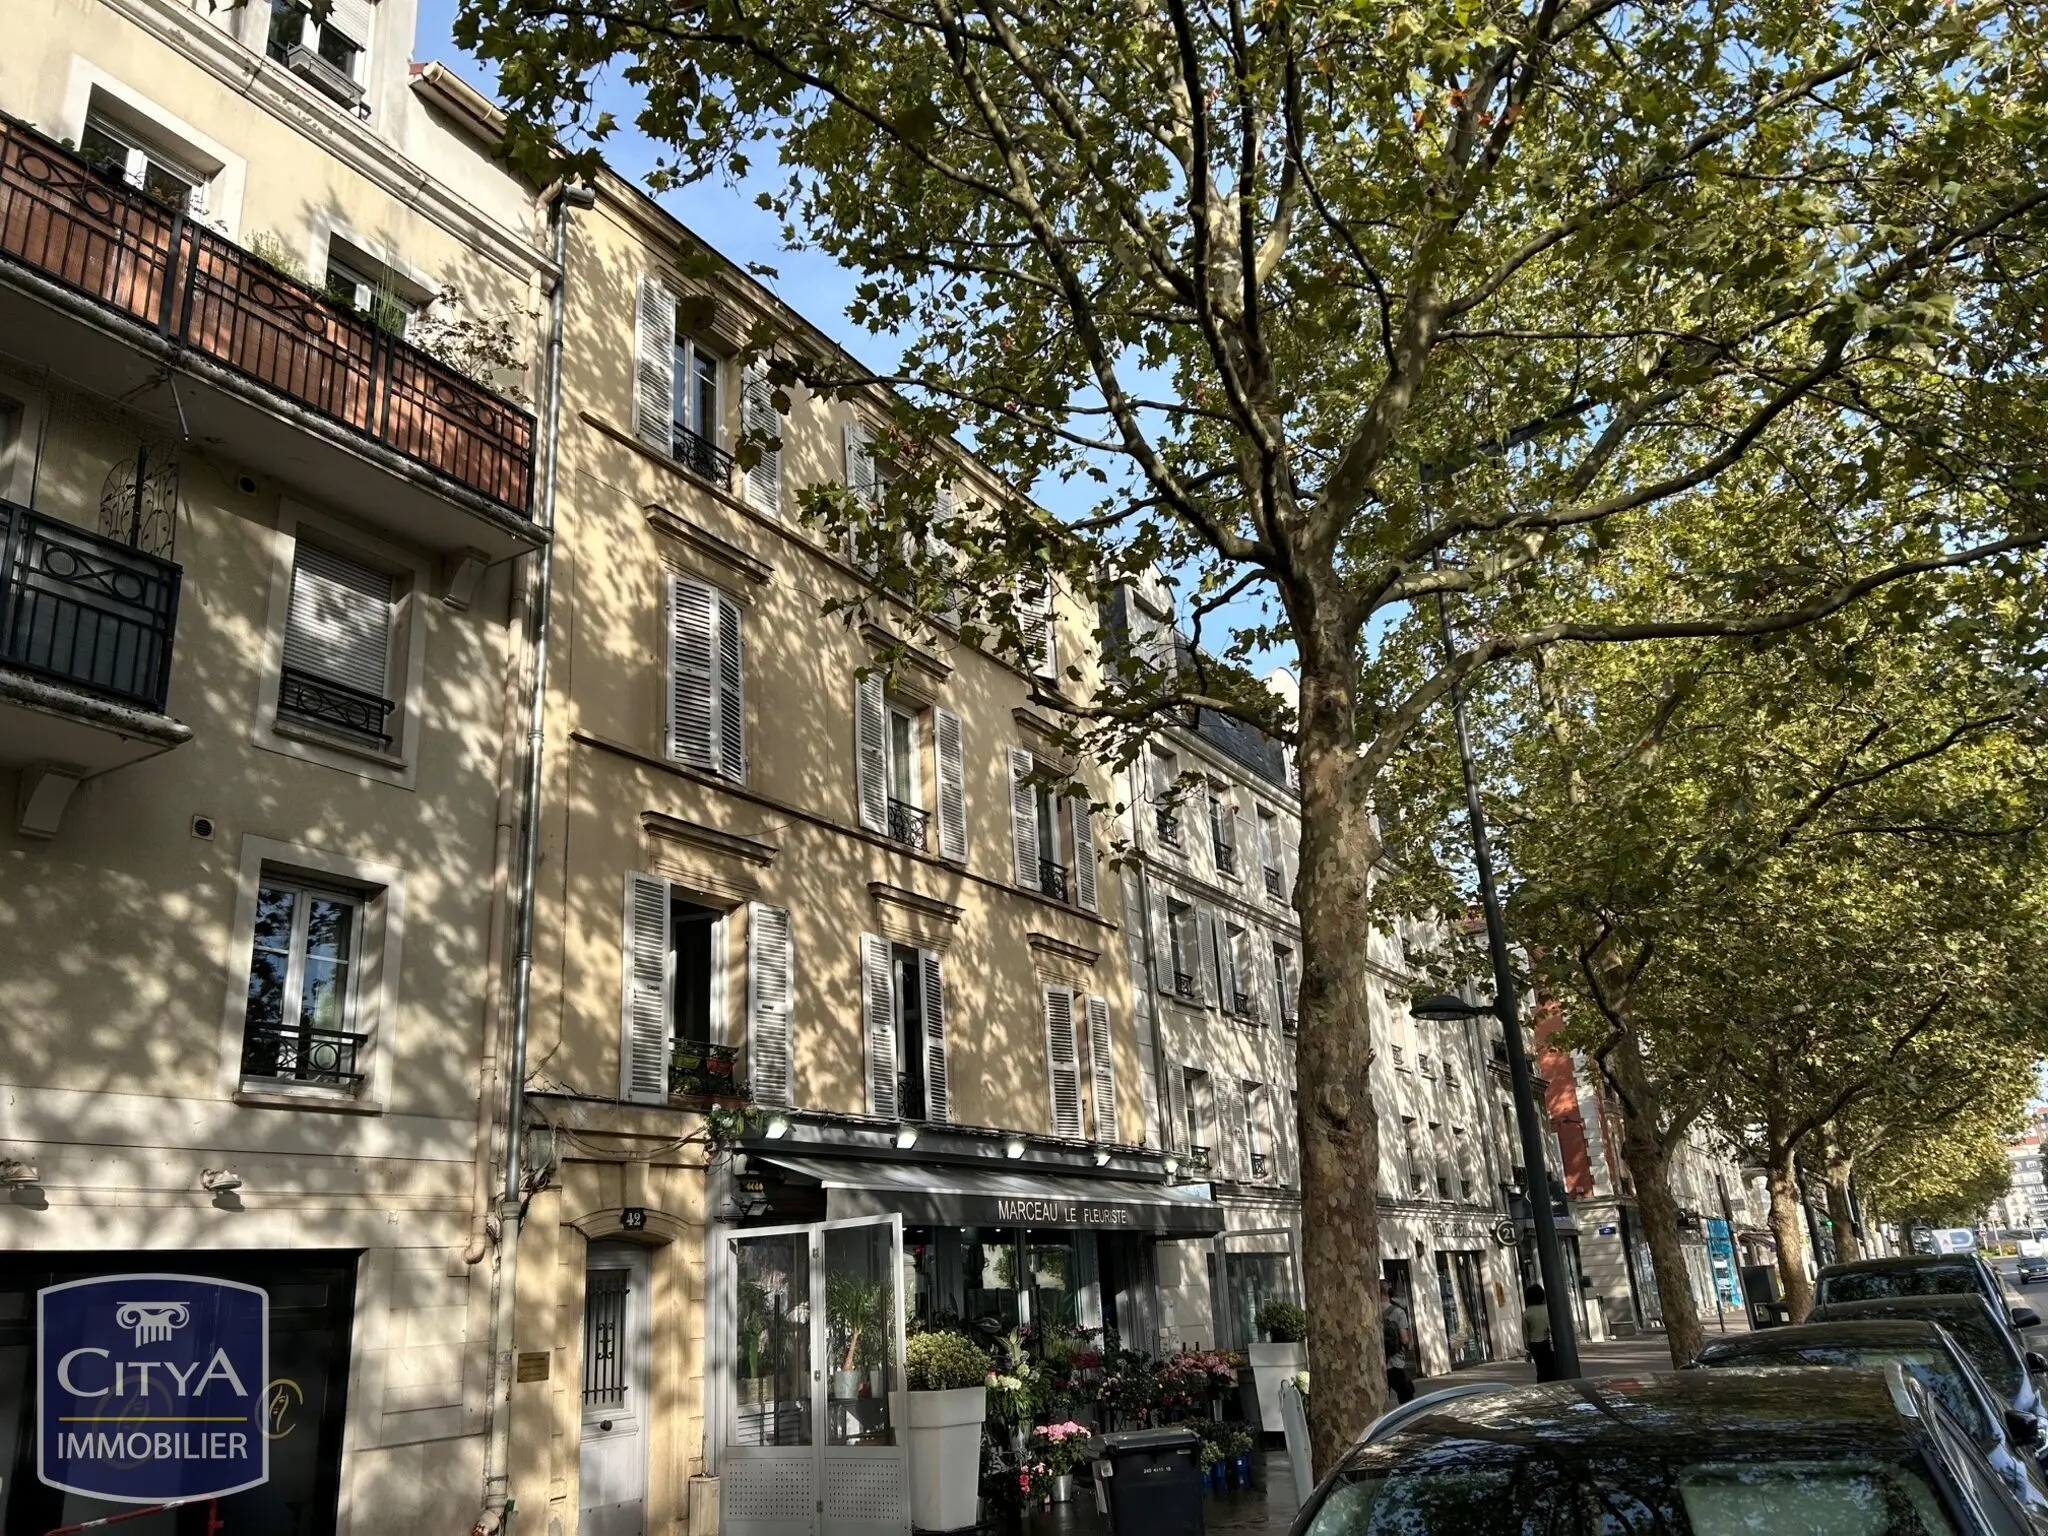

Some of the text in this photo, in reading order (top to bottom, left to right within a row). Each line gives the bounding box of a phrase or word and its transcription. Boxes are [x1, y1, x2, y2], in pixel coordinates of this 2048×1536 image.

[626, 1212, 641, 1226] 42
[998, 1200, 1127, 1224] MARCEAU LE FLEURISTE
